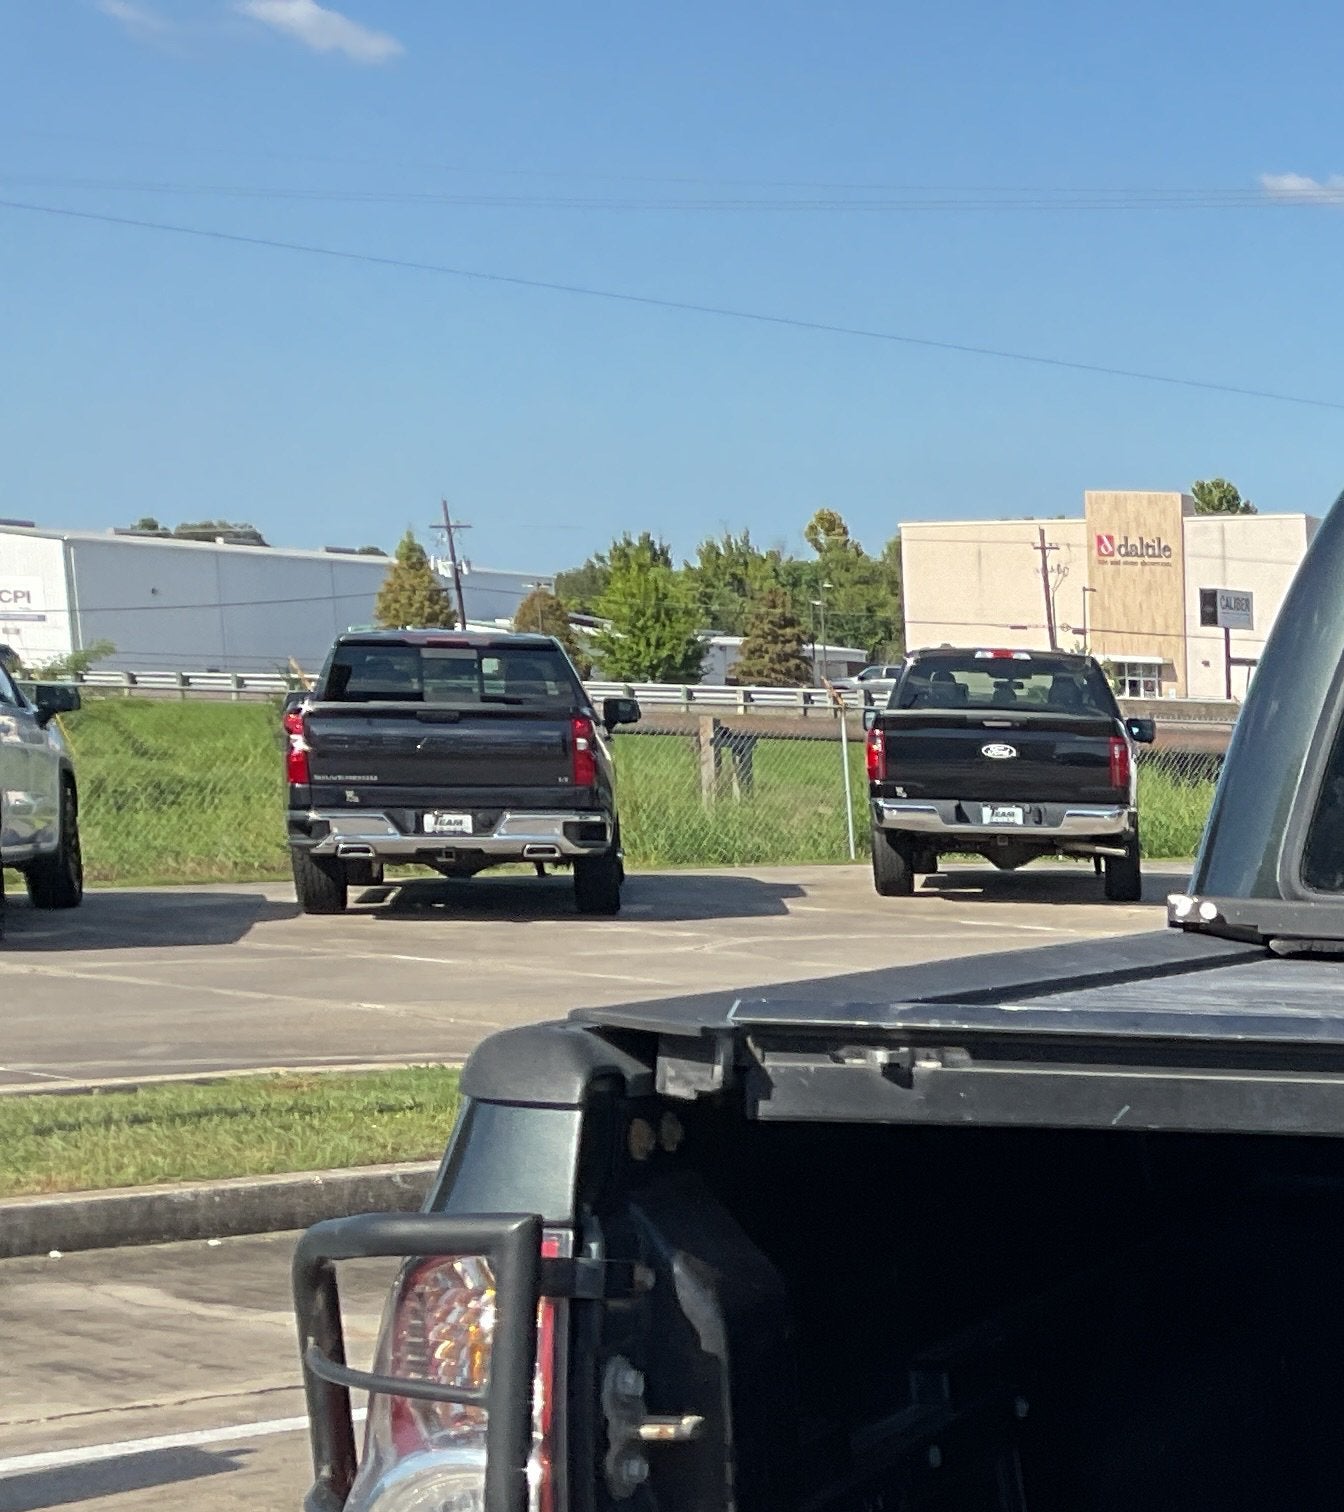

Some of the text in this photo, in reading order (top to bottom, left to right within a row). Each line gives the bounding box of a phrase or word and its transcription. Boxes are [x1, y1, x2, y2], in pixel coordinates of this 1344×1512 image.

[1117, 536, 1172, 559] daltile
[0, 590, 31, 604] CPI
[434, 816, 463, 826] TEAM
